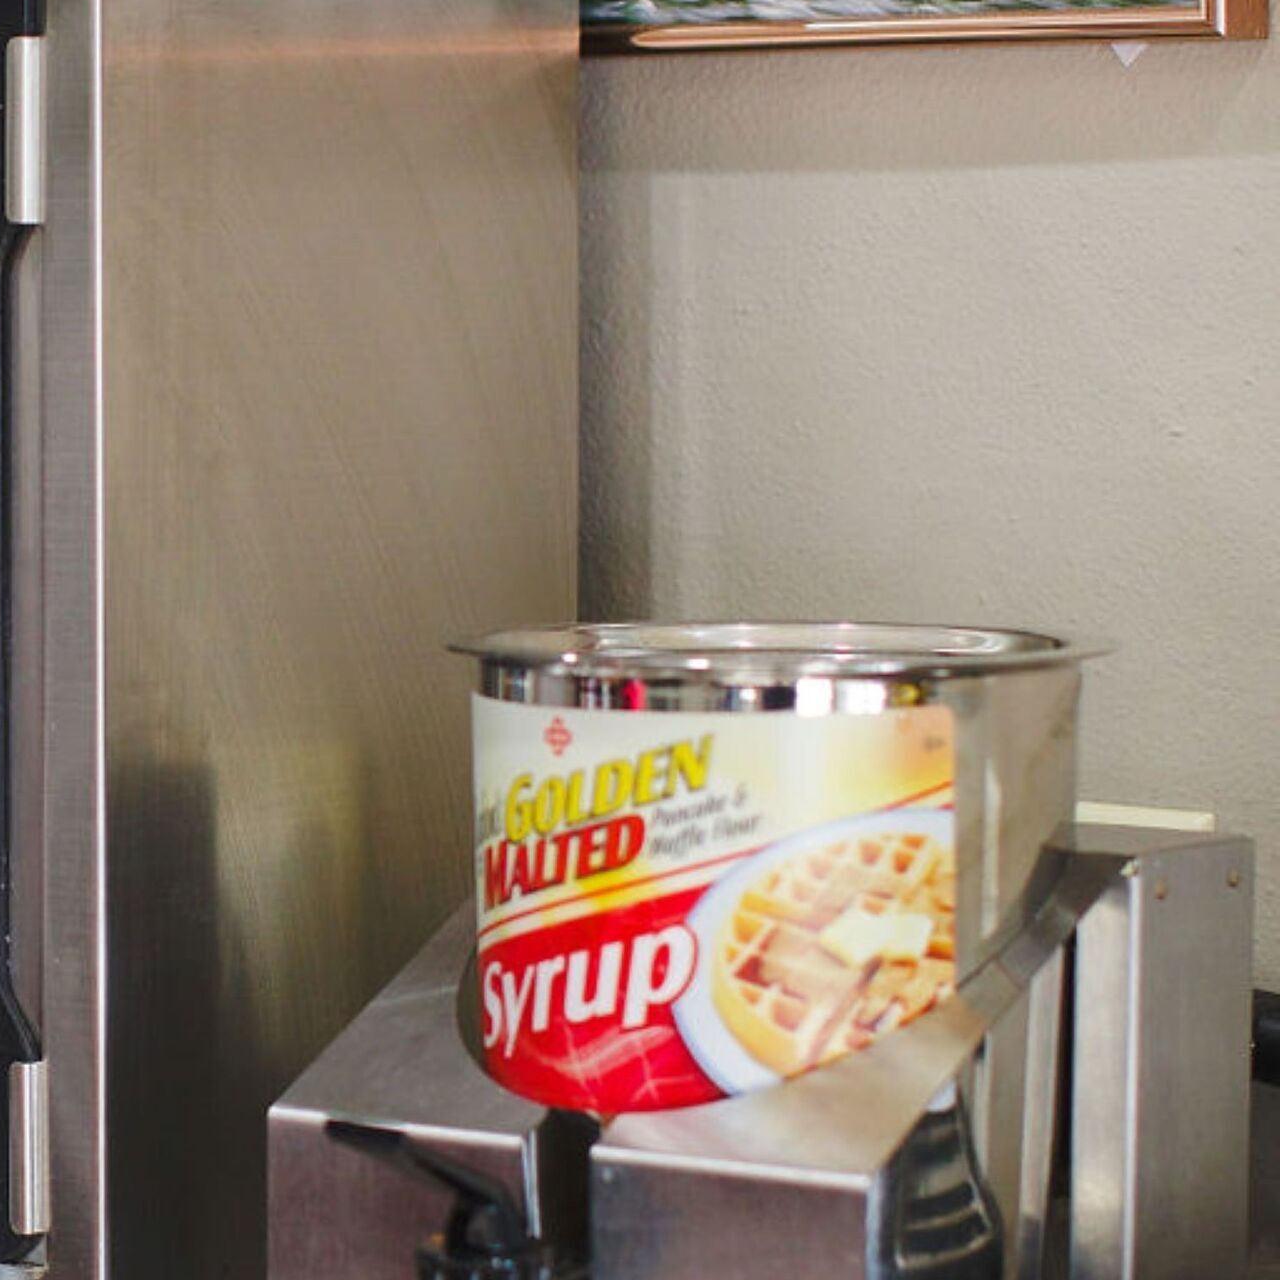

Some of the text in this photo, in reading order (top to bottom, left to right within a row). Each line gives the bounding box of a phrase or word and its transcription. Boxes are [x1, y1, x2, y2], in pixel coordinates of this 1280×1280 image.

[505, 733, 714, 844] GOLDEN
[483, 813, 646, 912] MALTED
[482, 925, 697, 1058] Syrup
